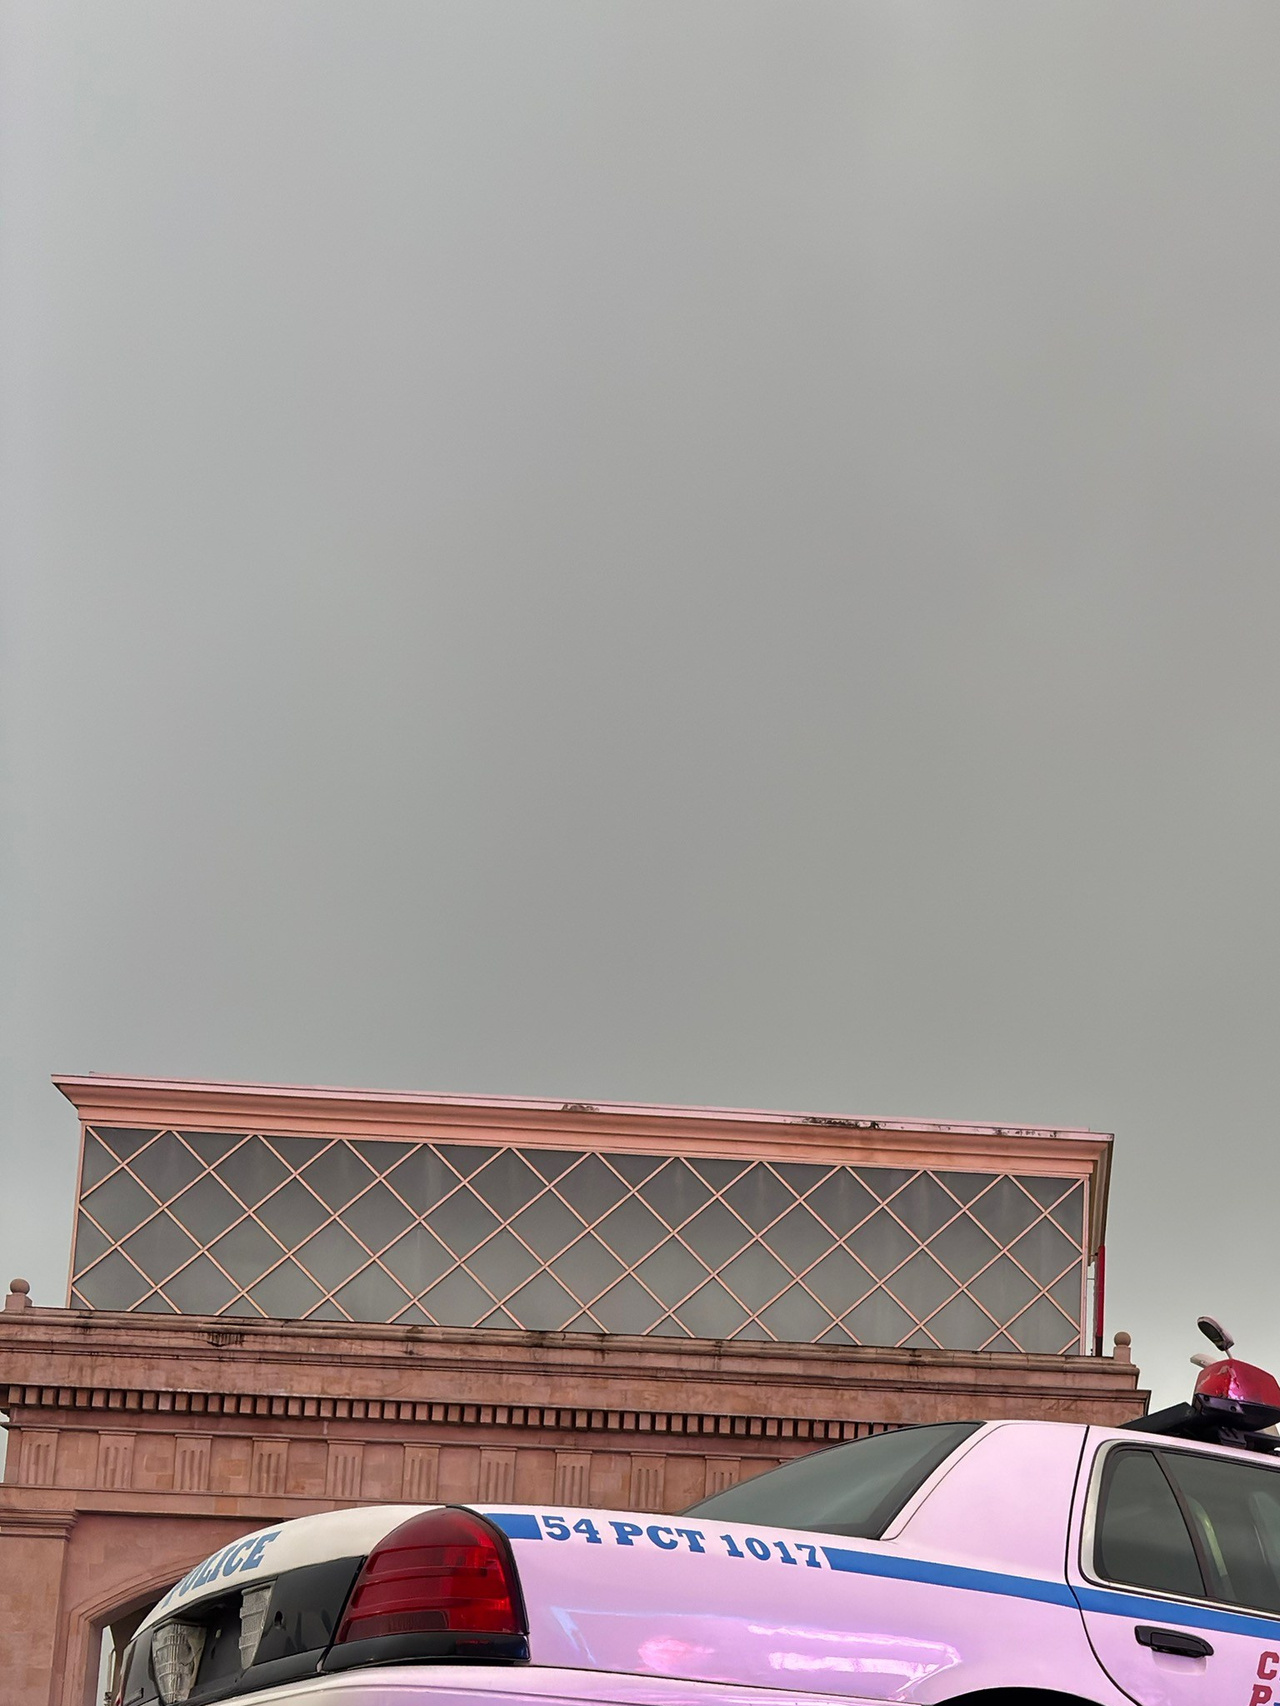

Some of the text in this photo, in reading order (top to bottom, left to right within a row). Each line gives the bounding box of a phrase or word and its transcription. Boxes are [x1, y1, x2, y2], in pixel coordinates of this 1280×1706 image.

[541, 1515, 822, 1568] 54 PCT 1017
